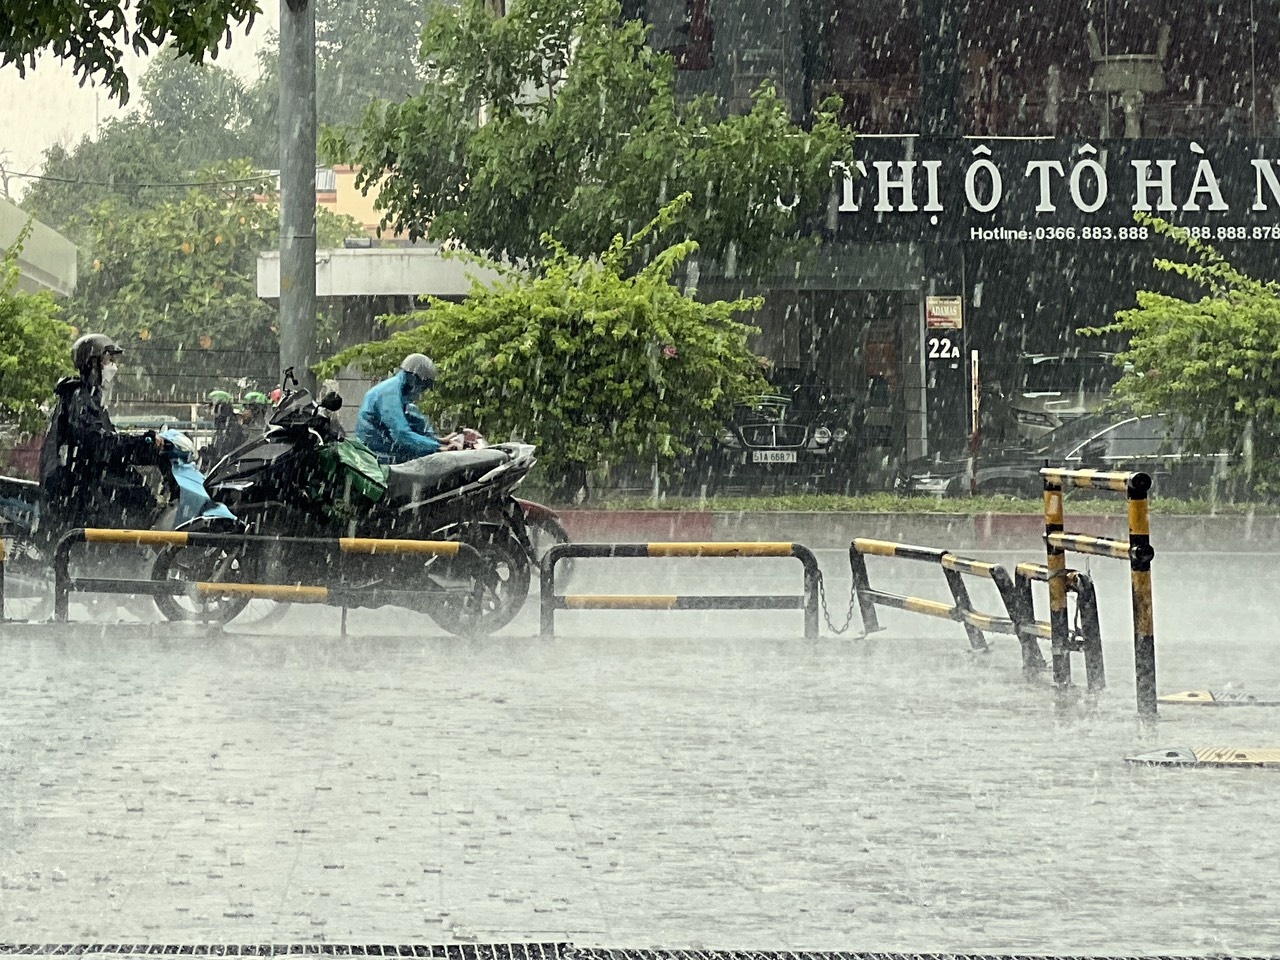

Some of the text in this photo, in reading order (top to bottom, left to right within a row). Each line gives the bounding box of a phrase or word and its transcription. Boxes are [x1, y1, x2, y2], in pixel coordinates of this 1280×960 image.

[829, 160, 944, 225] THỊ
[965, 144, 1002, 212] Ô
[1024, 143, 1108, 213] TÔ
[1131, 141, 1230, 211] HÀ
[970, 226, 1033, 240] Hotline:
[1035, 226, 1149, 240] 0366.883.888
